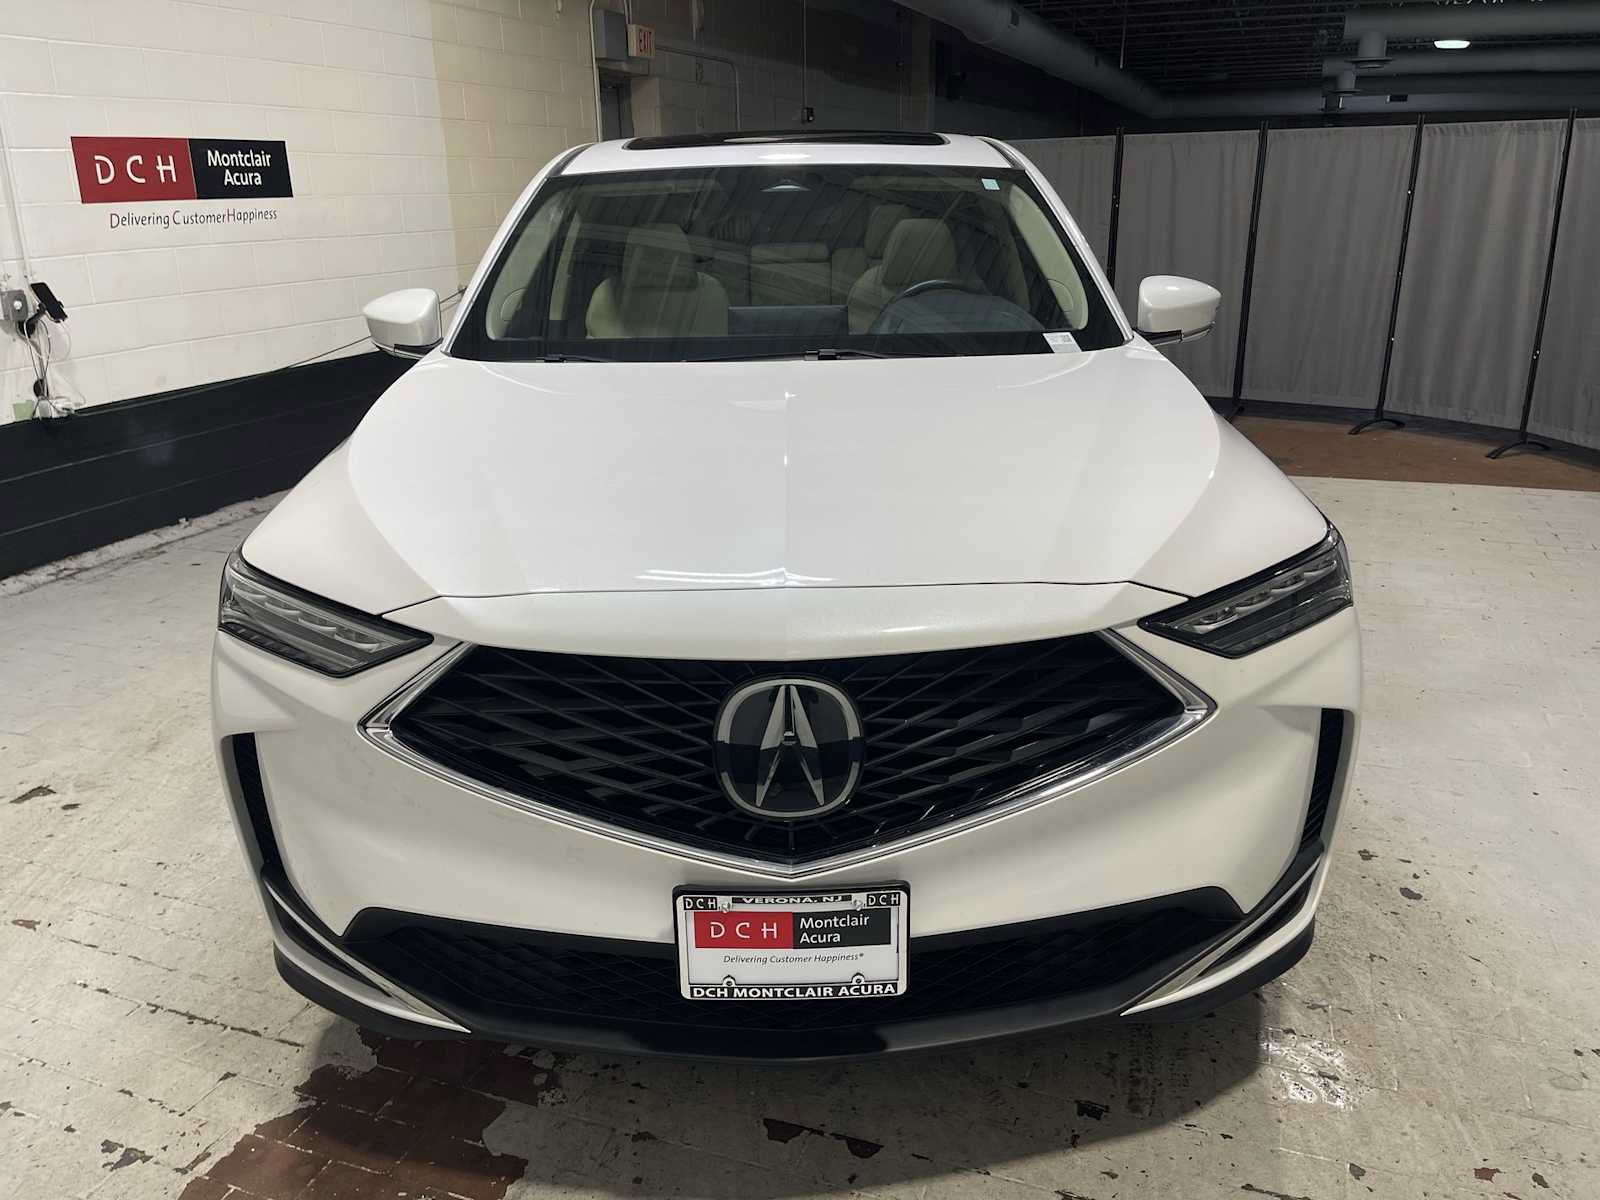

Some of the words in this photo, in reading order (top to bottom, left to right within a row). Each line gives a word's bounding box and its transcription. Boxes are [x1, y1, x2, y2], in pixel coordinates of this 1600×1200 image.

[207, 149, 272, 167] Montclair
[93, 154, 177, 185] DCH
[224, 169, 263, 186] Acura
[110, 212, 170, 229] Delivering
[684, 898, 717, 909] DCH
[868, 893, 900, 906] DCH
[799, 914, 870, 929] Montclair
[709, 921, 778, 939] DCH
[799, 932, 841, 944] Acura
[723, 955, 768, 965] Delivering
[769, 955, 812, 963] Customer
[693, 987, 728, 997] DCH
[733, 987, 833, 998] MONTCLAIR
[838, 984, 896, 996] ACURA
